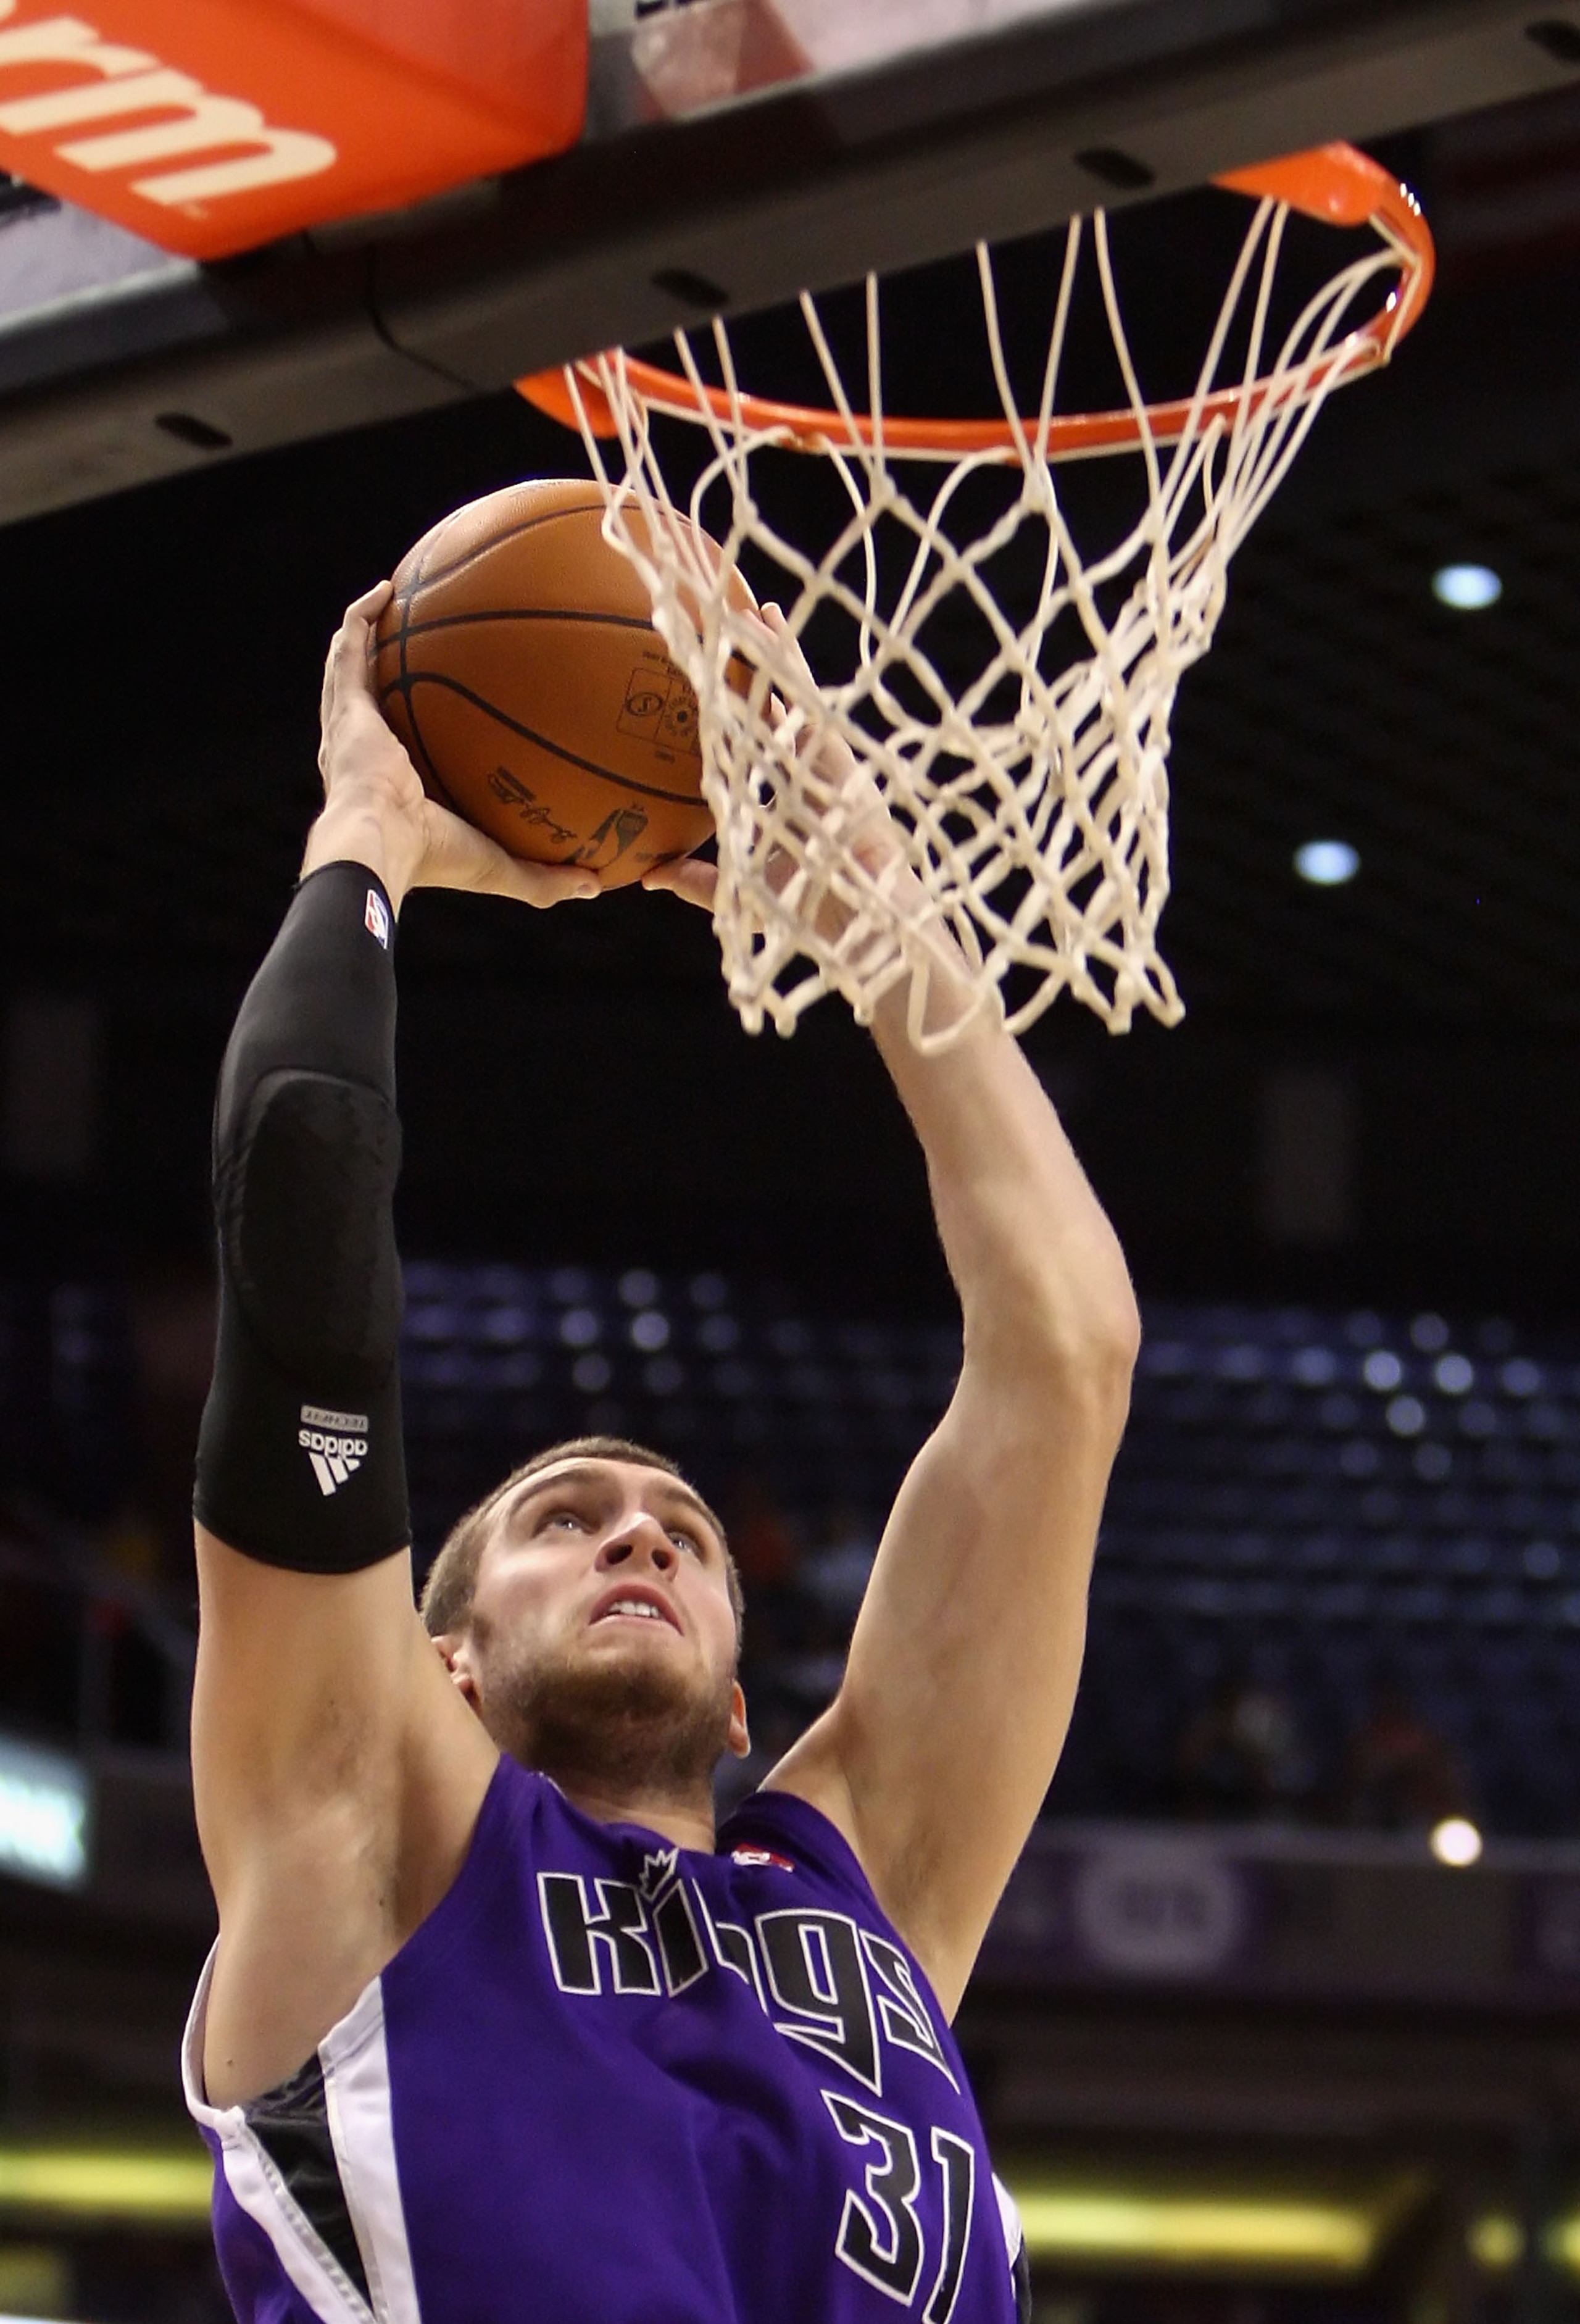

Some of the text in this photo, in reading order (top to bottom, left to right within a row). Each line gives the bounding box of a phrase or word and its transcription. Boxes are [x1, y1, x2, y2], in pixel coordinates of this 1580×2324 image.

[0, 0, 337, 206] rm
[298, 1428, 368, 1458] adidas
[820, 2089, 975, 2324] 31
